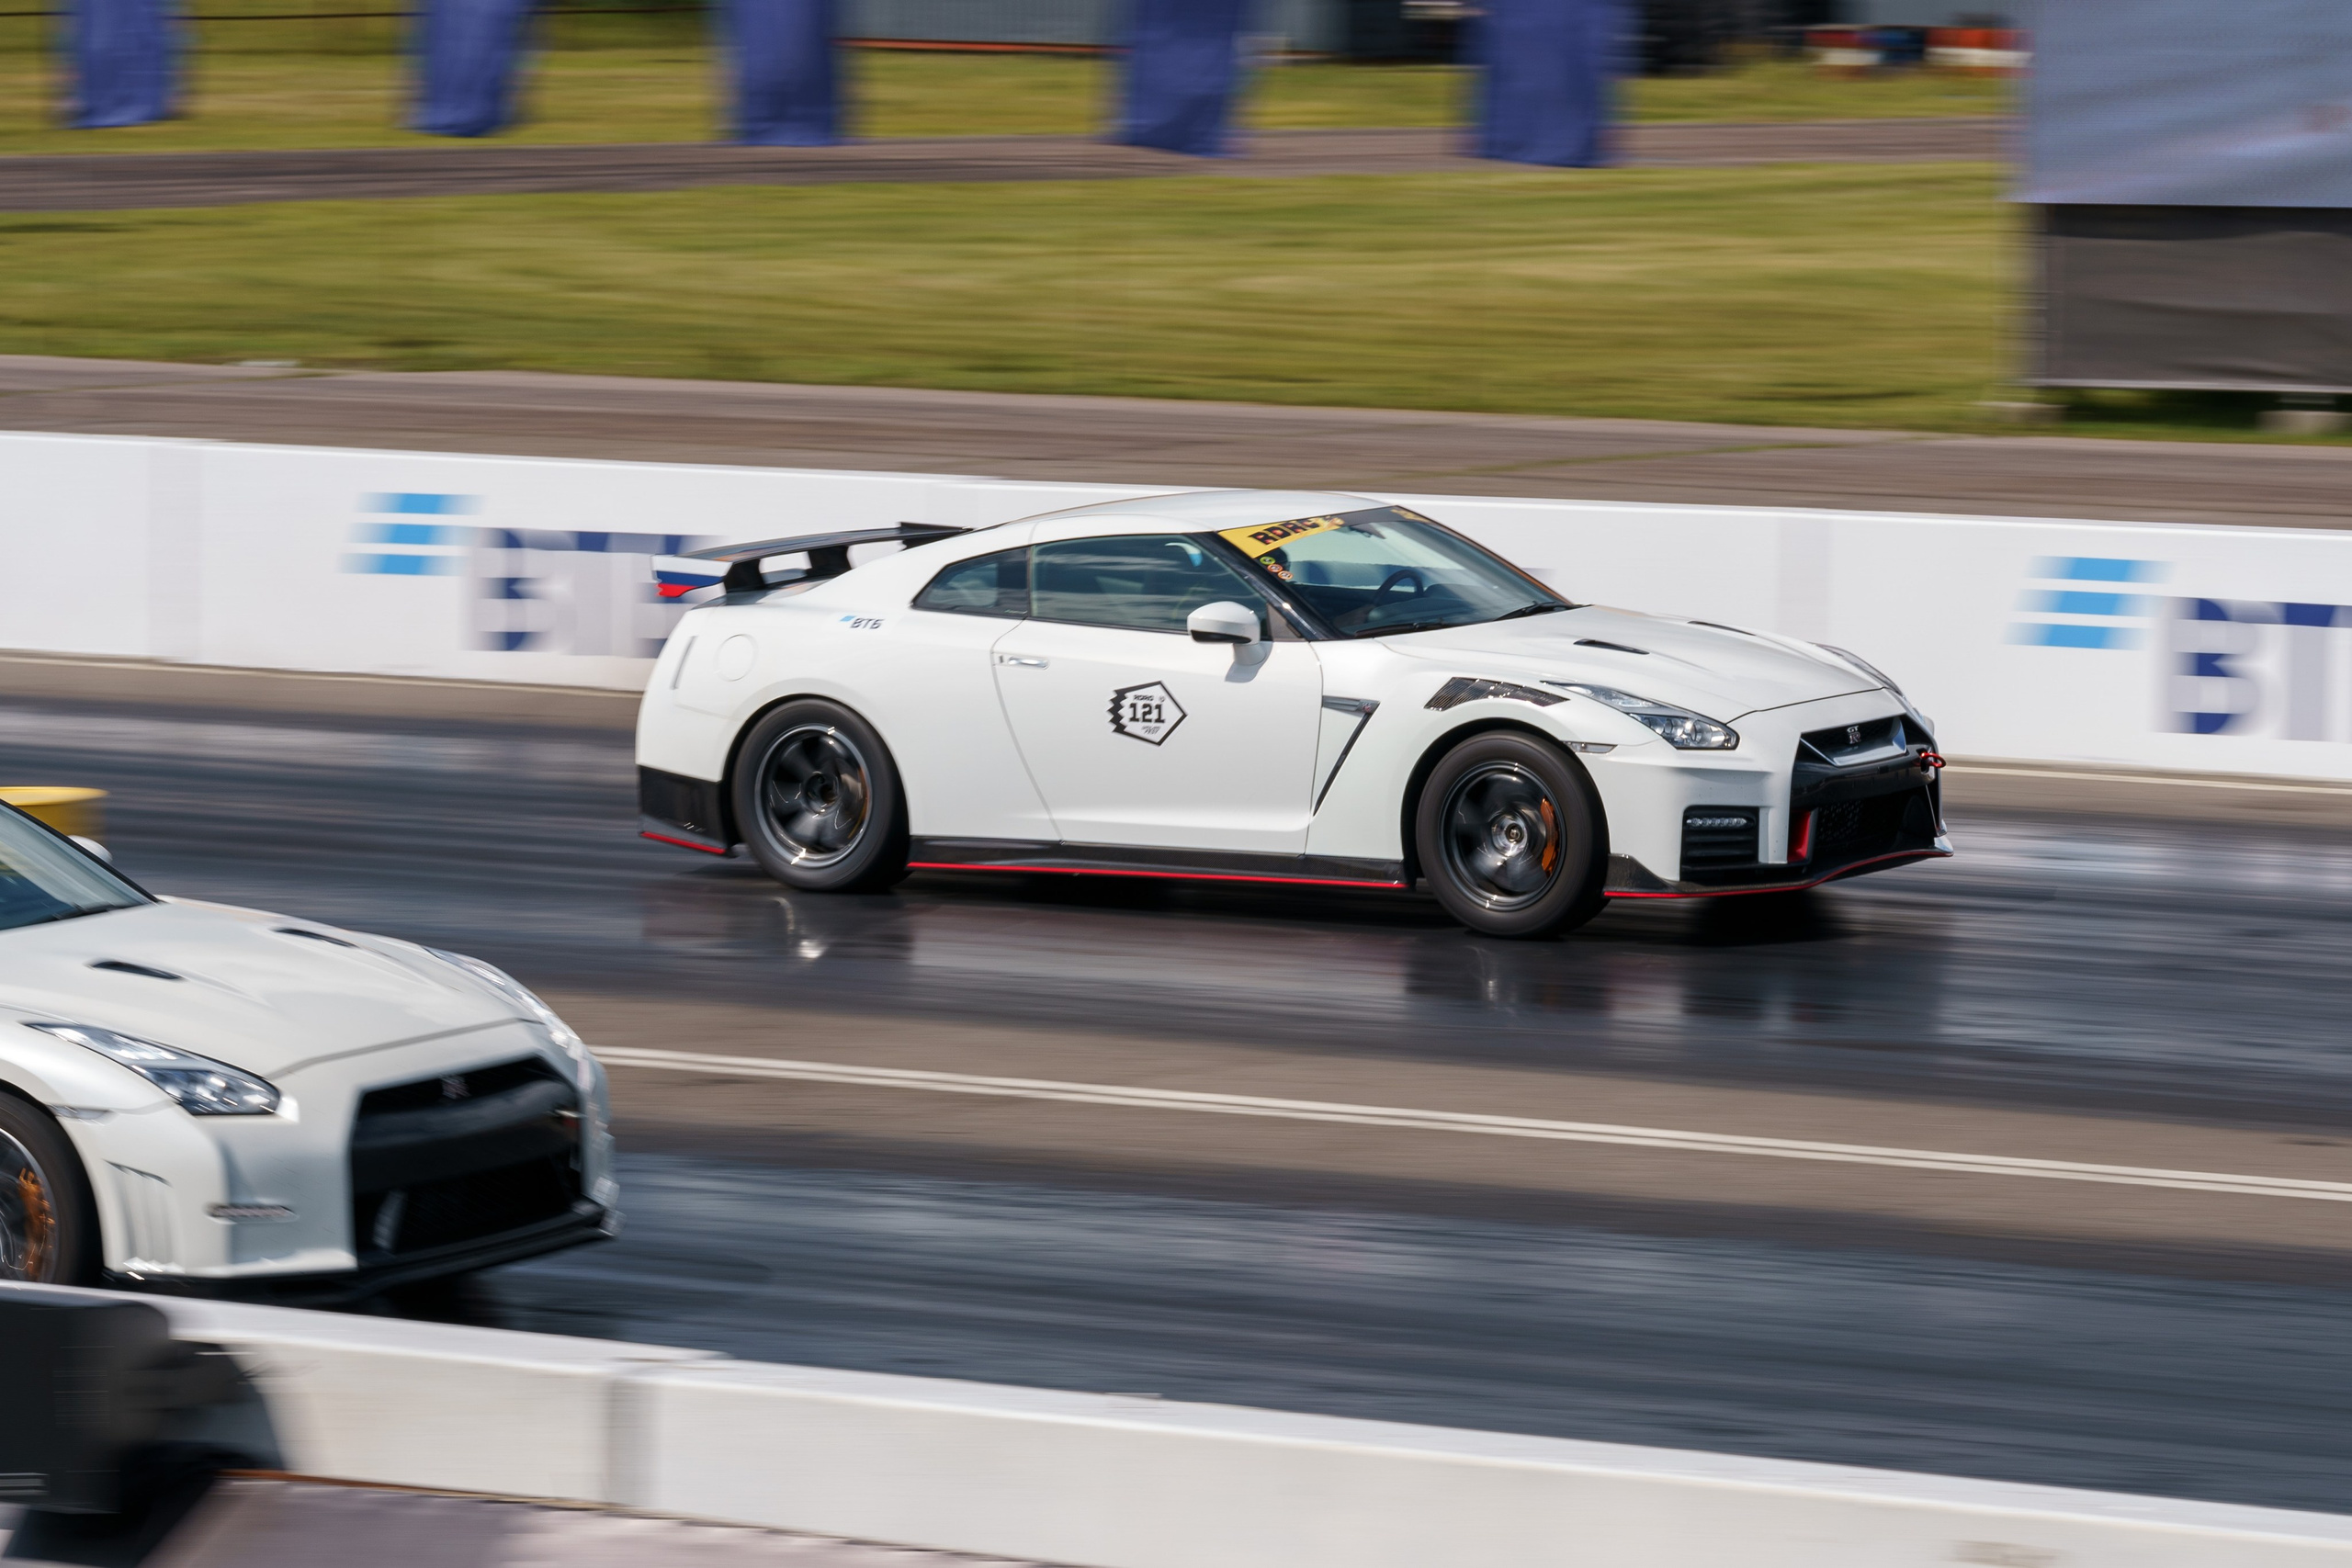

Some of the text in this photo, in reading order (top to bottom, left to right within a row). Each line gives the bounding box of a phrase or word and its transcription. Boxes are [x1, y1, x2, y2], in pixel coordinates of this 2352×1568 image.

[850, 617, 885, 630] ВТБ
[2154, 595, 2352, 742] ВТ
[1128, 702, 1165, 724] 121
